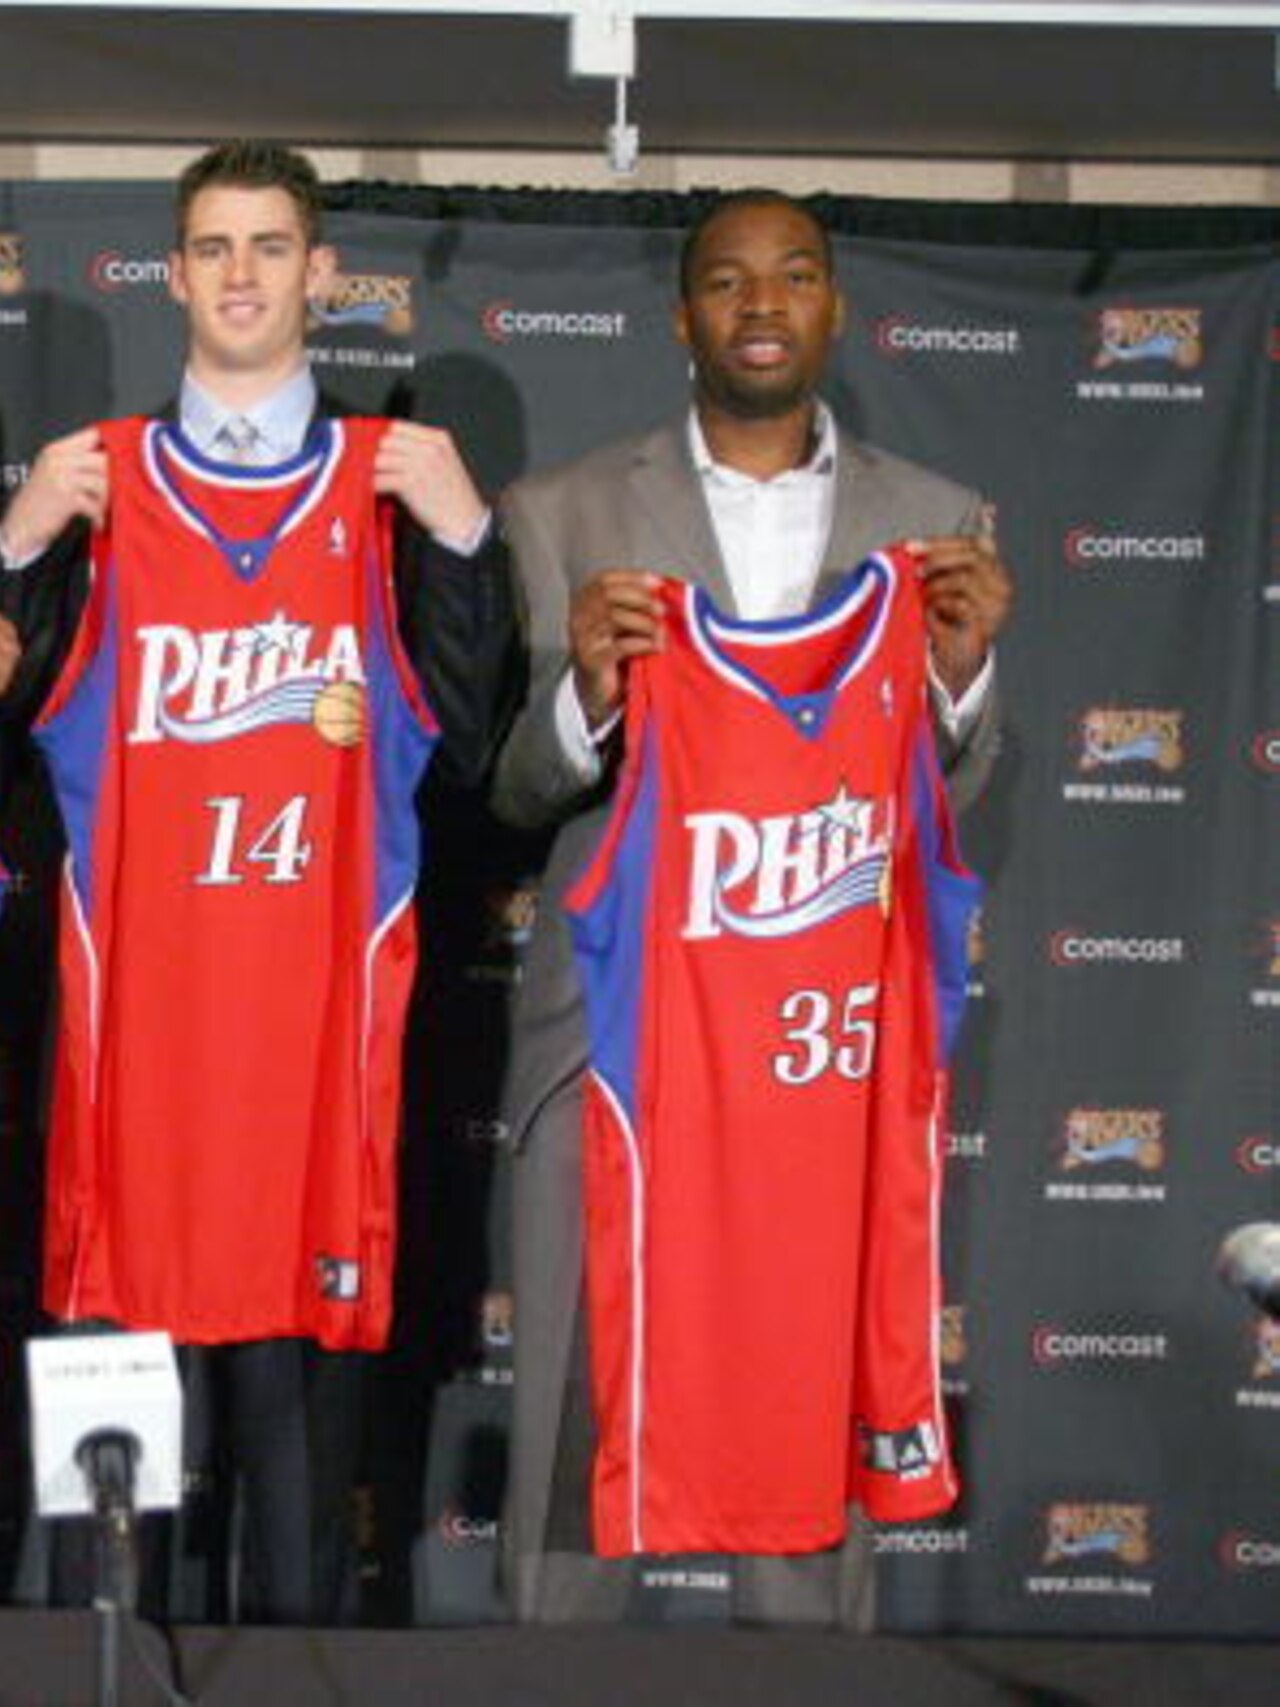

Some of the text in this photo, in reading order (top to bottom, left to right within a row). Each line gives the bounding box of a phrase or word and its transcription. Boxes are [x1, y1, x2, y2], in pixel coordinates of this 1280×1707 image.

[498, 309, 626, 337] comcast
[888, 326, 1018, 354] comcast
[1077, 530, 1204, 558] comcast
[194, 794, 312, 885] 14
[1062, 938, 1183, 962] comcast
[773, 980, 880, 1085] 35
[1043, 1333, 1167, 1358] comcast
